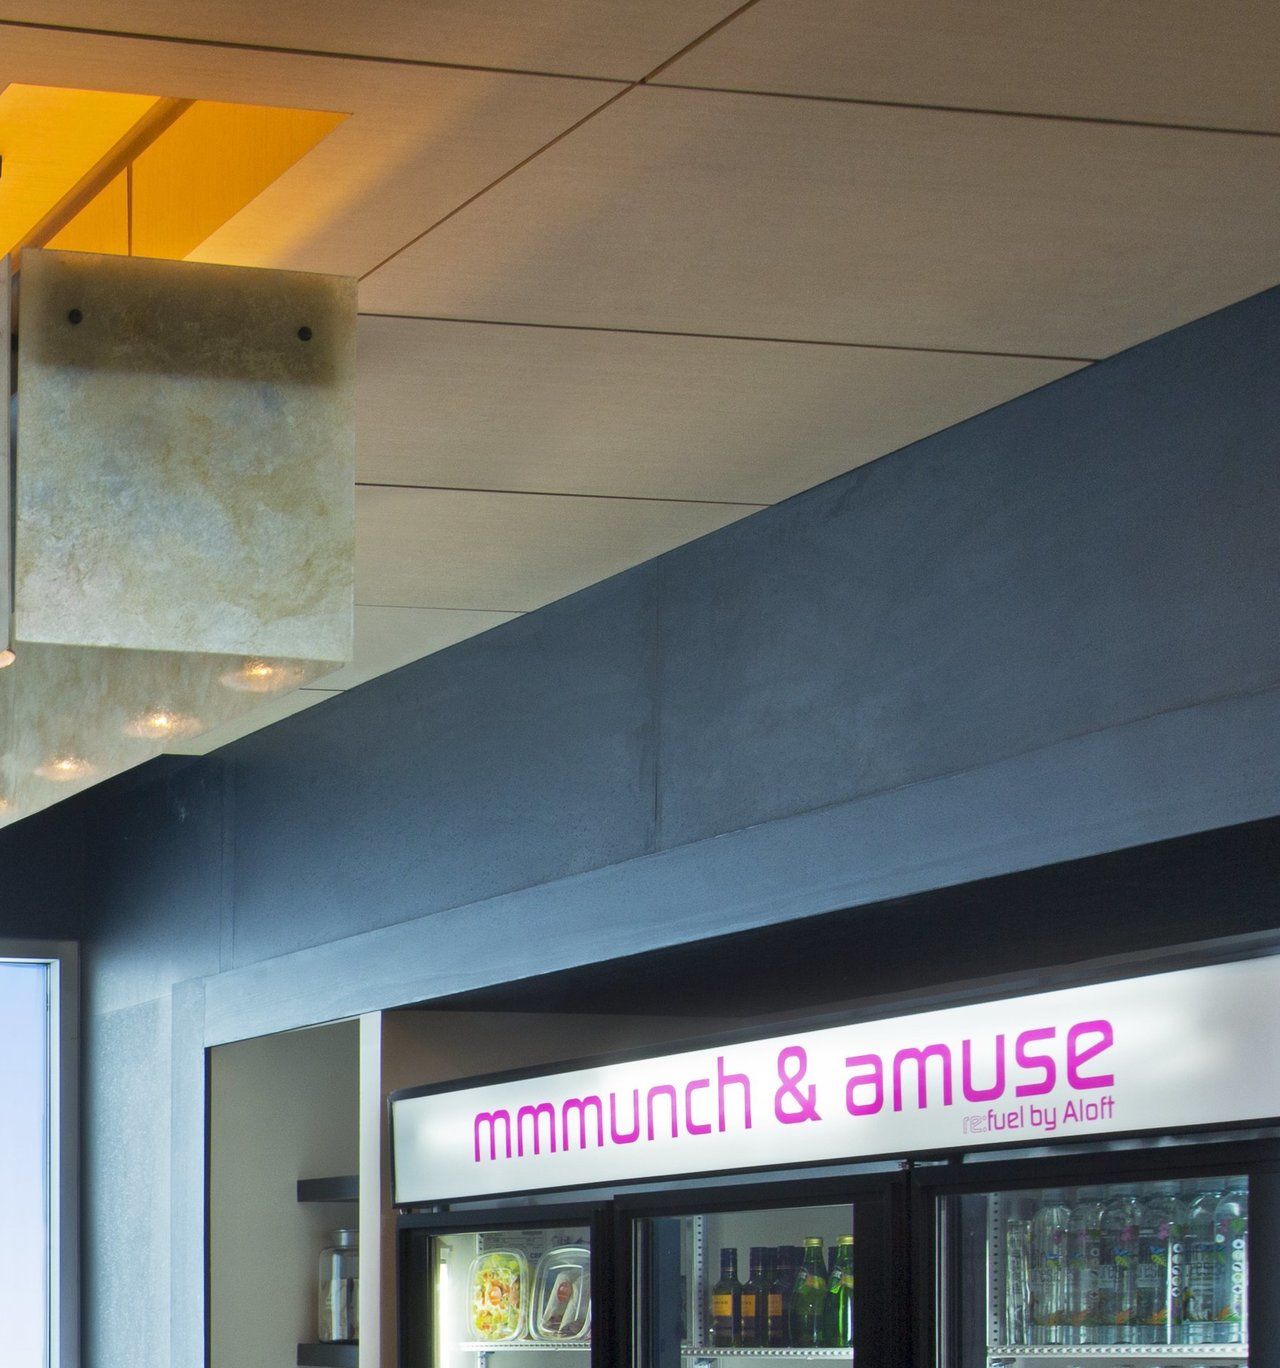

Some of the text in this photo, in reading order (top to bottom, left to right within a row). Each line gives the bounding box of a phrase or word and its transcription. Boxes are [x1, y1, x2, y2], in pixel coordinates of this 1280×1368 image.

[474, 1019, 1115, 1162] mmmunch & amuse
[962, 1096, 1115, 1135] re:fuel by Aloft
